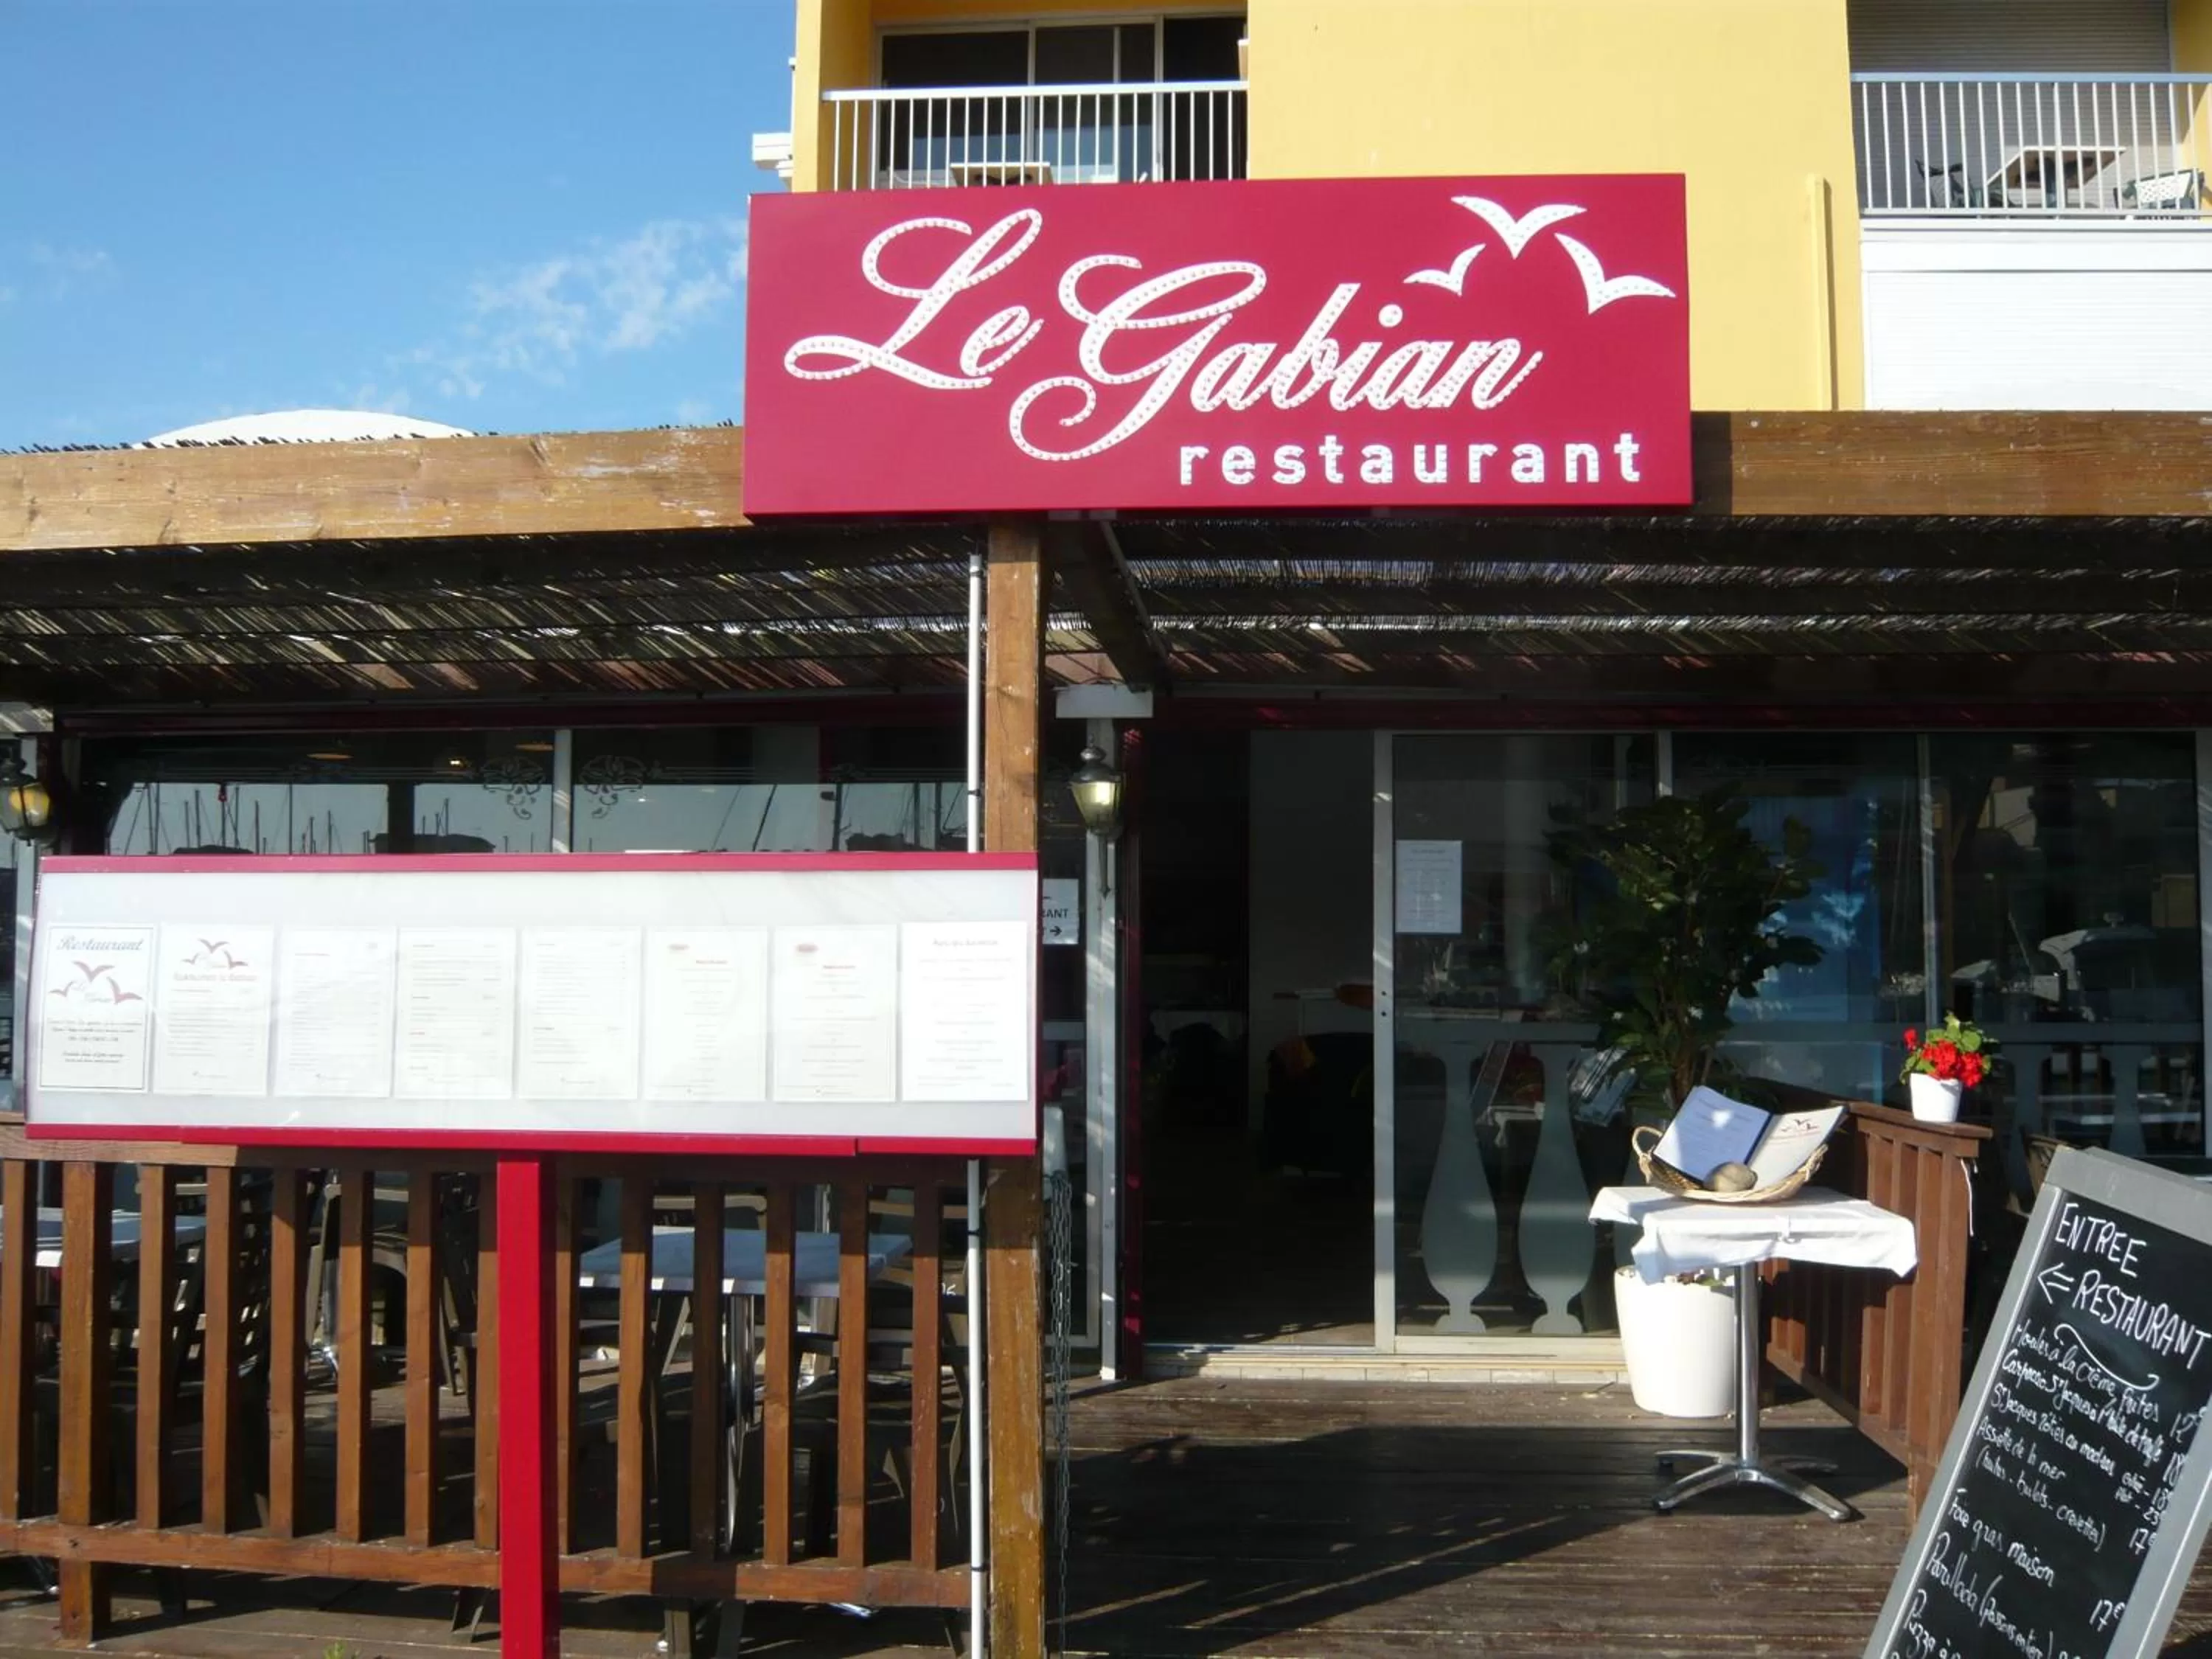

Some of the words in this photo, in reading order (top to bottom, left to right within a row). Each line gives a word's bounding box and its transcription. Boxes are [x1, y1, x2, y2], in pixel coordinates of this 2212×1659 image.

[784, 208, 1044, 390] Le
[1009, 254, 1543, 462] Gabian
[1180, 434, 1641, 486] restaurant
[56, 935, 145, 951] Restaurant
[2055, 1203, 2147, 1279] ENTREE
[2072, 1270, 2212, 1369] RESTAURANT
